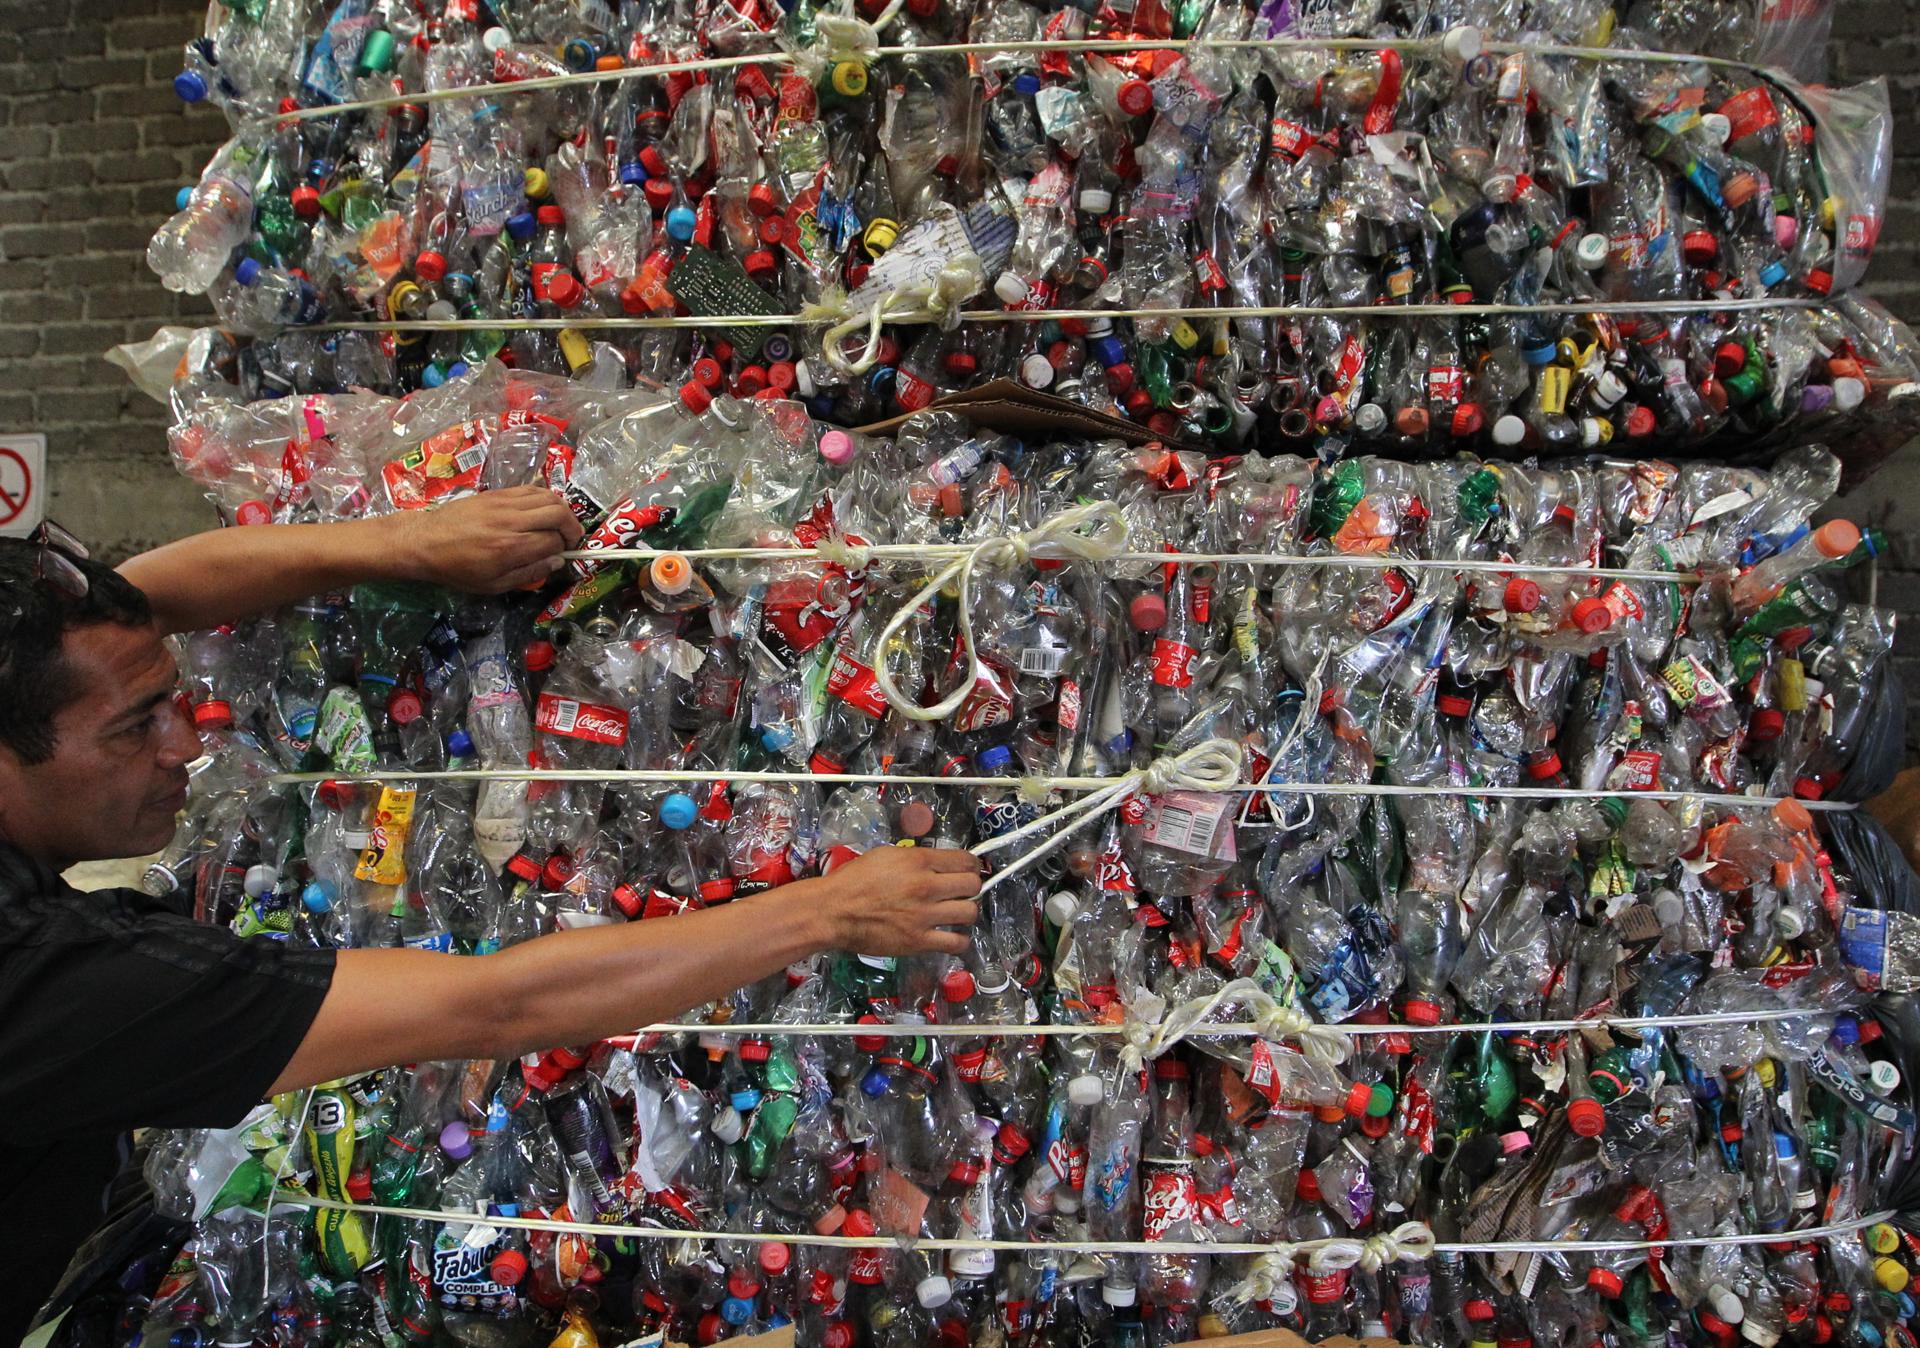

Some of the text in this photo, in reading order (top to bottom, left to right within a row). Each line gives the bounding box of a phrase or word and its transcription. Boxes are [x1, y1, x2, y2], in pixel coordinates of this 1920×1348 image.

[571, 585, 598, 598] Jugo
[576, 712, 625, 738] Coca-Cola
[310, 1103, 340, 1127] 13
